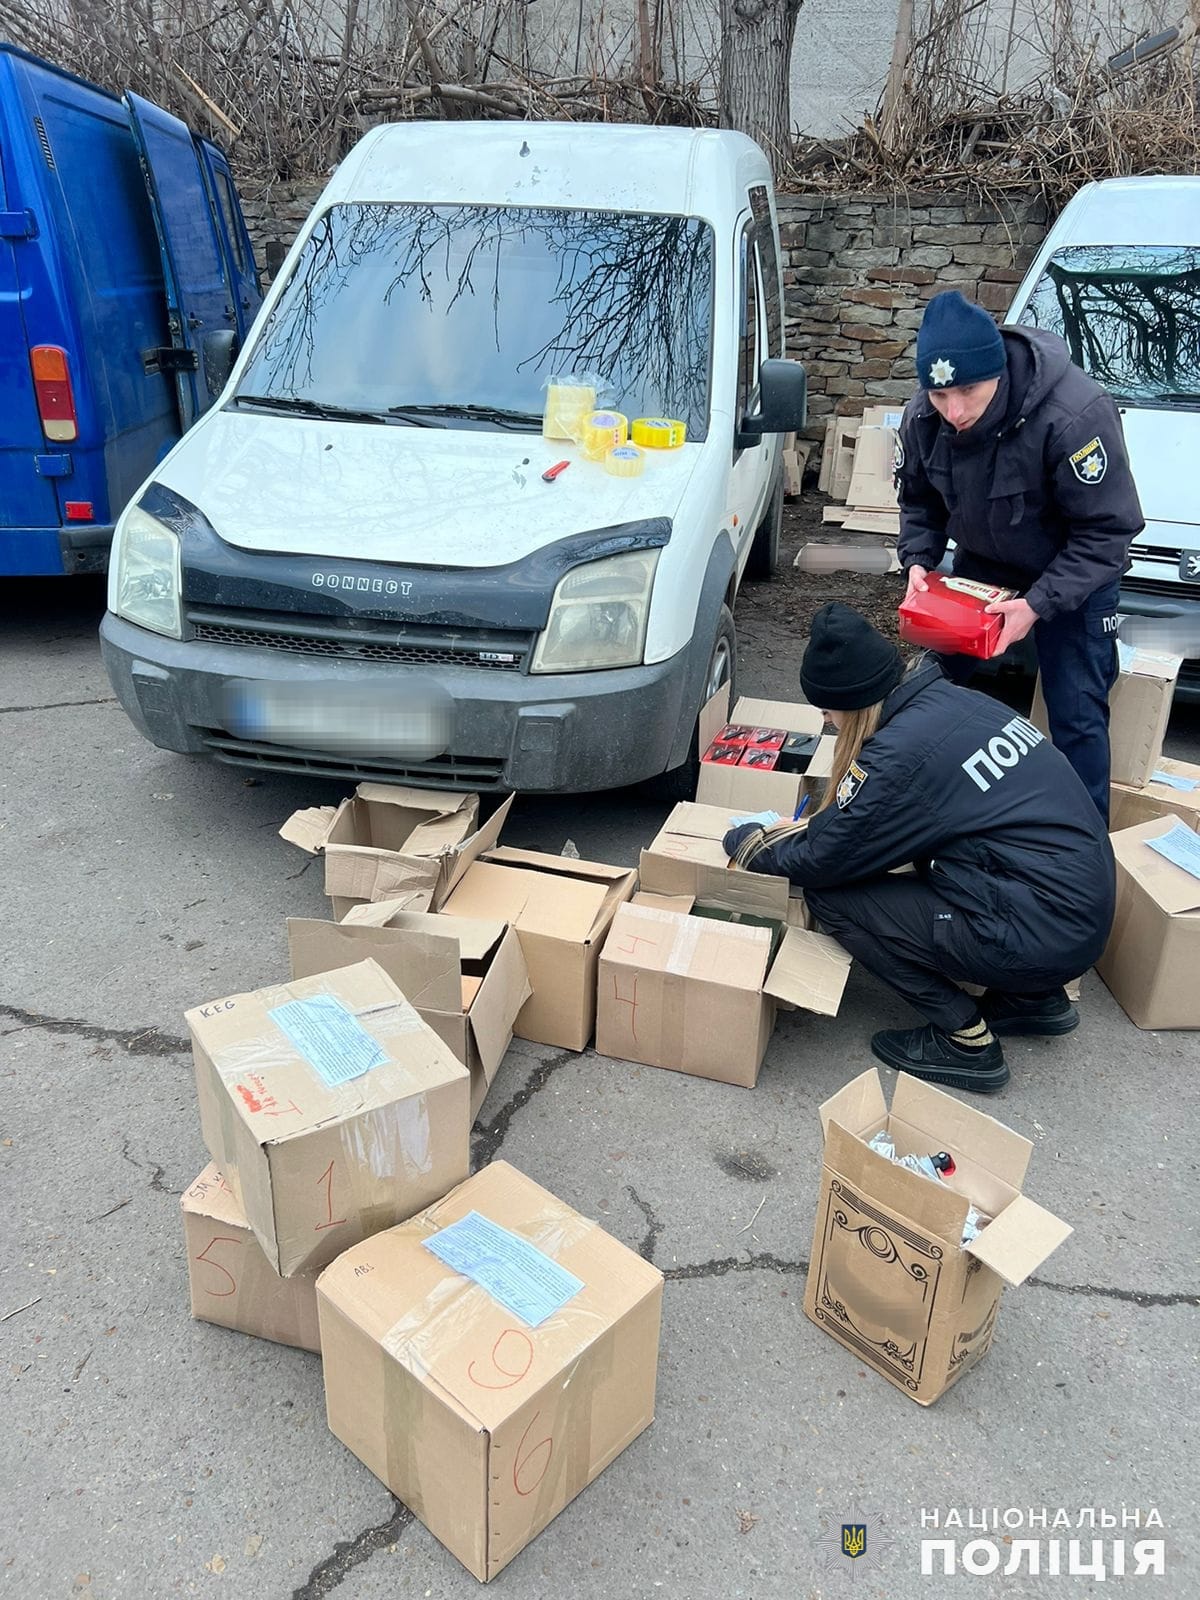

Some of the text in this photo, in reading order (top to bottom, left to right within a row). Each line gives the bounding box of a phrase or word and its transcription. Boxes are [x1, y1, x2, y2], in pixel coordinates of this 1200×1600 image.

[312, 573, 413, 595] CONNECT
[200, 1000, 236, 1018] KEG
[613, 974, 639, 1043] 4
[315, 1160, 347, 1231] 1
[196, 1237, 242, 1297] 5
[513, 1410, 553, 1497] 6
